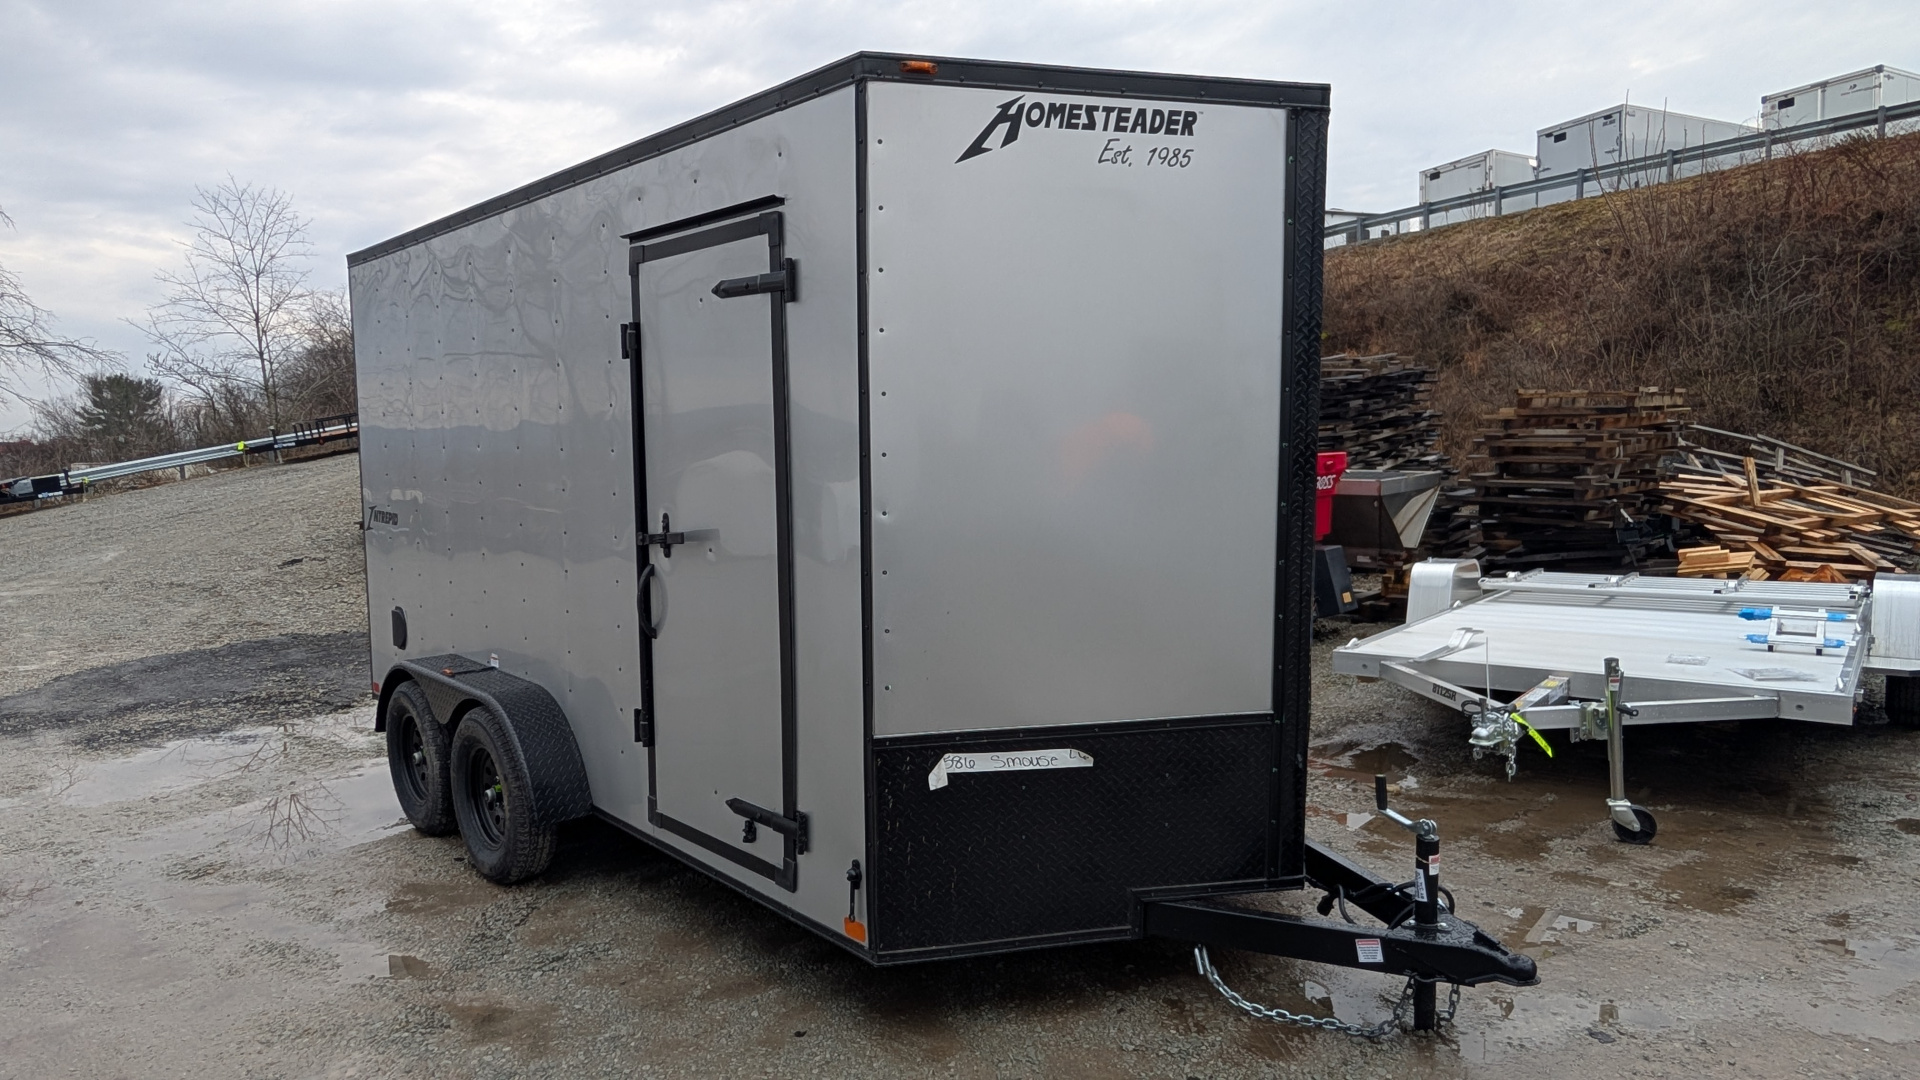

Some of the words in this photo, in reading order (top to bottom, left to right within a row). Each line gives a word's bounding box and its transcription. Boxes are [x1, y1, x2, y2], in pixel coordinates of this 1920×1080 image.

[955, 94, 1198, 164] HOMESTEADER
[1098, 138, 1132, 167] Est.
[1147, 147, 1194, 168] 1985
[366, 505, 399, 531] INTREPID
[991, 755, 1058, 769] Smouse
